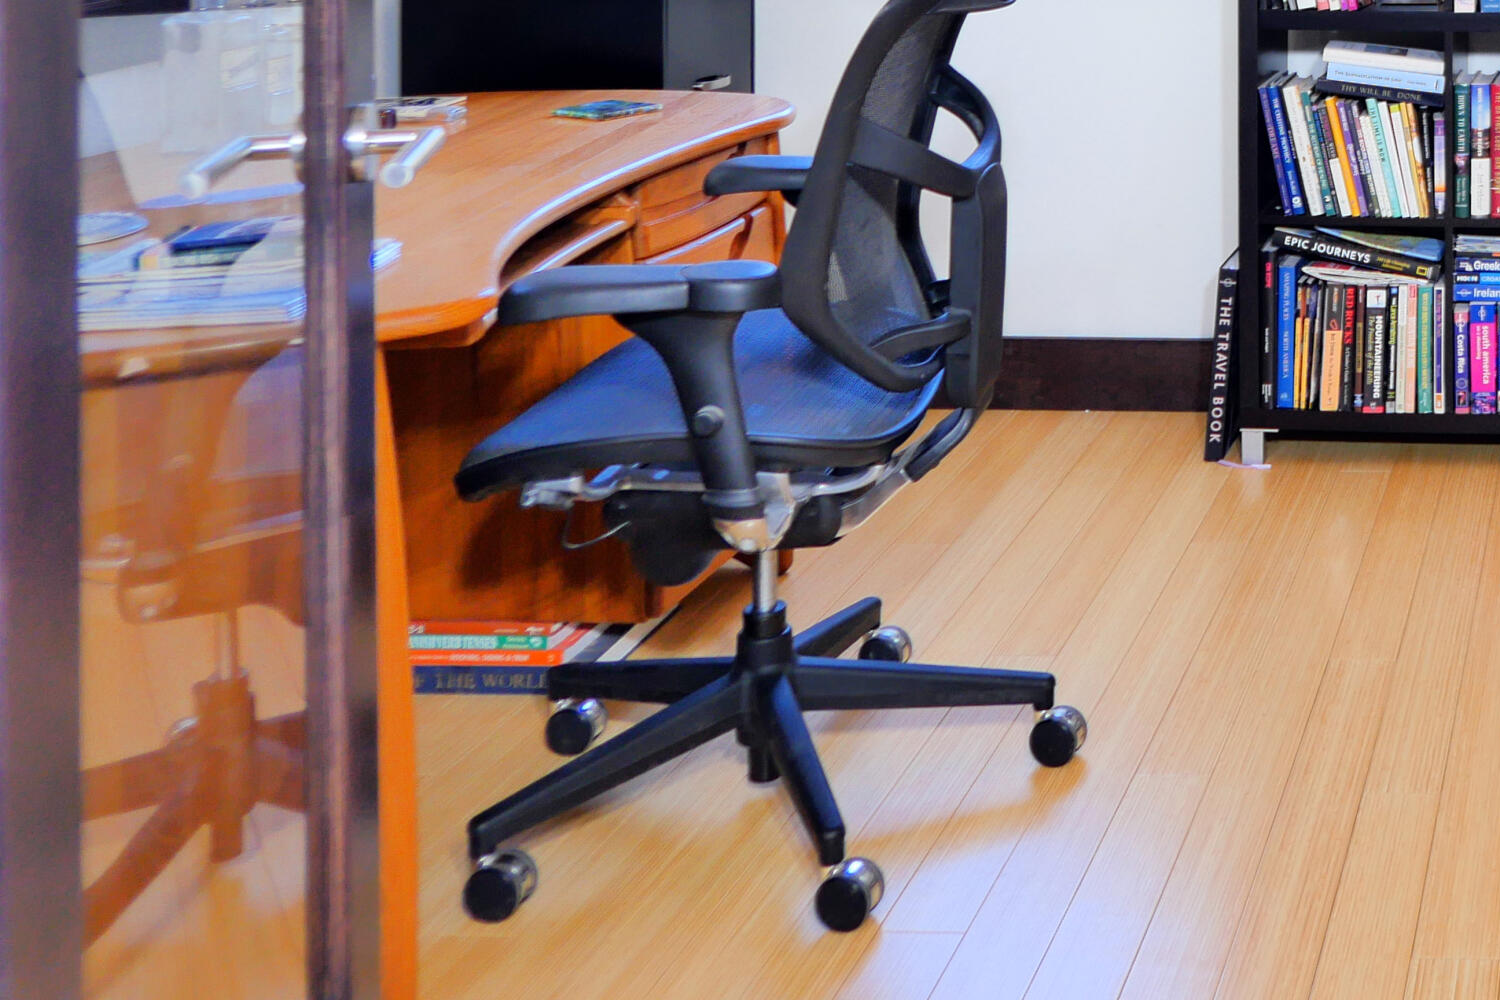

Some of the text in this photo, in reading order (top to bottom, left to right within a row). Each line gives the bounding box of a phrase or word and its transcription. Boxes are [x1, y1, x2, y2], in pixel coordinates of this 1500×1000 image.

[1341, 84, 1357, 92] THY
[1360, 87, 1379, 96] WILL
[1397, 92, 1421, 101] DONE
[1458, 118, 1466, 128] TO
[1458, 130, 1466, 152] EARTH
[1284, 236, 1310, 250] EPIC
[1311, 242, 1371, 264] JOURNEYS
[1473, 260, 1500, 271] Greek
[1344, 287, 1355, 344] RED ROCKS
[1373, 316, 1383, 398] MOUNTAINEERING
[1457, 334, 1465, 373] Costa Rica
[1482, 326, 1490, 384] south america
[1209, 297, 1233, 443] THE TRAVEL BOOK
[435, 673, 476, 688] THE
